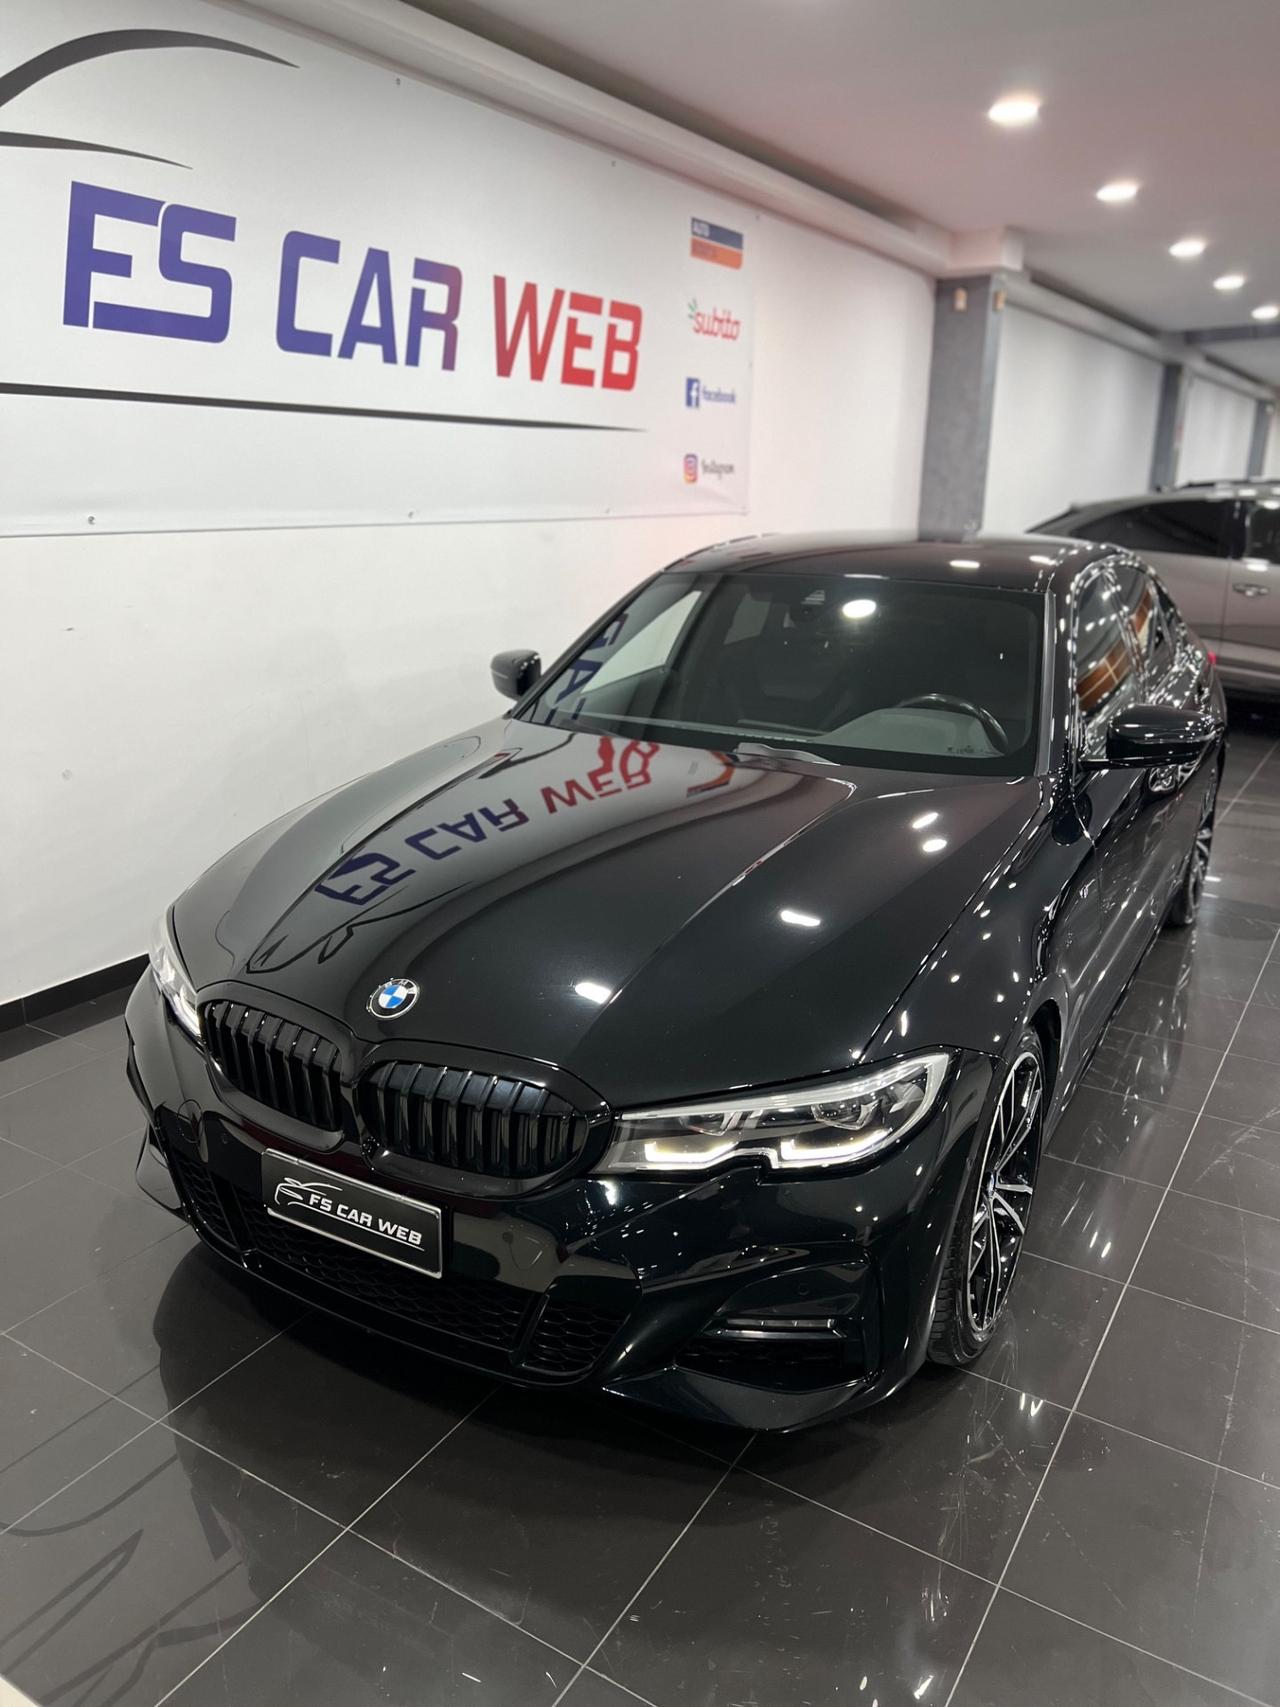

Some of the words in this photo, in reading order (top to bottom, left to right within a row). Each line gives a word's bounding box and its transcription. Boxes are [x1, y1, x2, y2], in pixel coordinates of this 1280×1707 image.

[63, 180, 237, 343] FS
[276, 230, 463, 371] CAR
[492, 274, 643, 392] WEB
[692, 306, 741, 341] subito
[309, 1193, 333, 1212] FS
[336, 1204, 373, 1227] CAR
[378, 1218, 422, 1245] WEB
